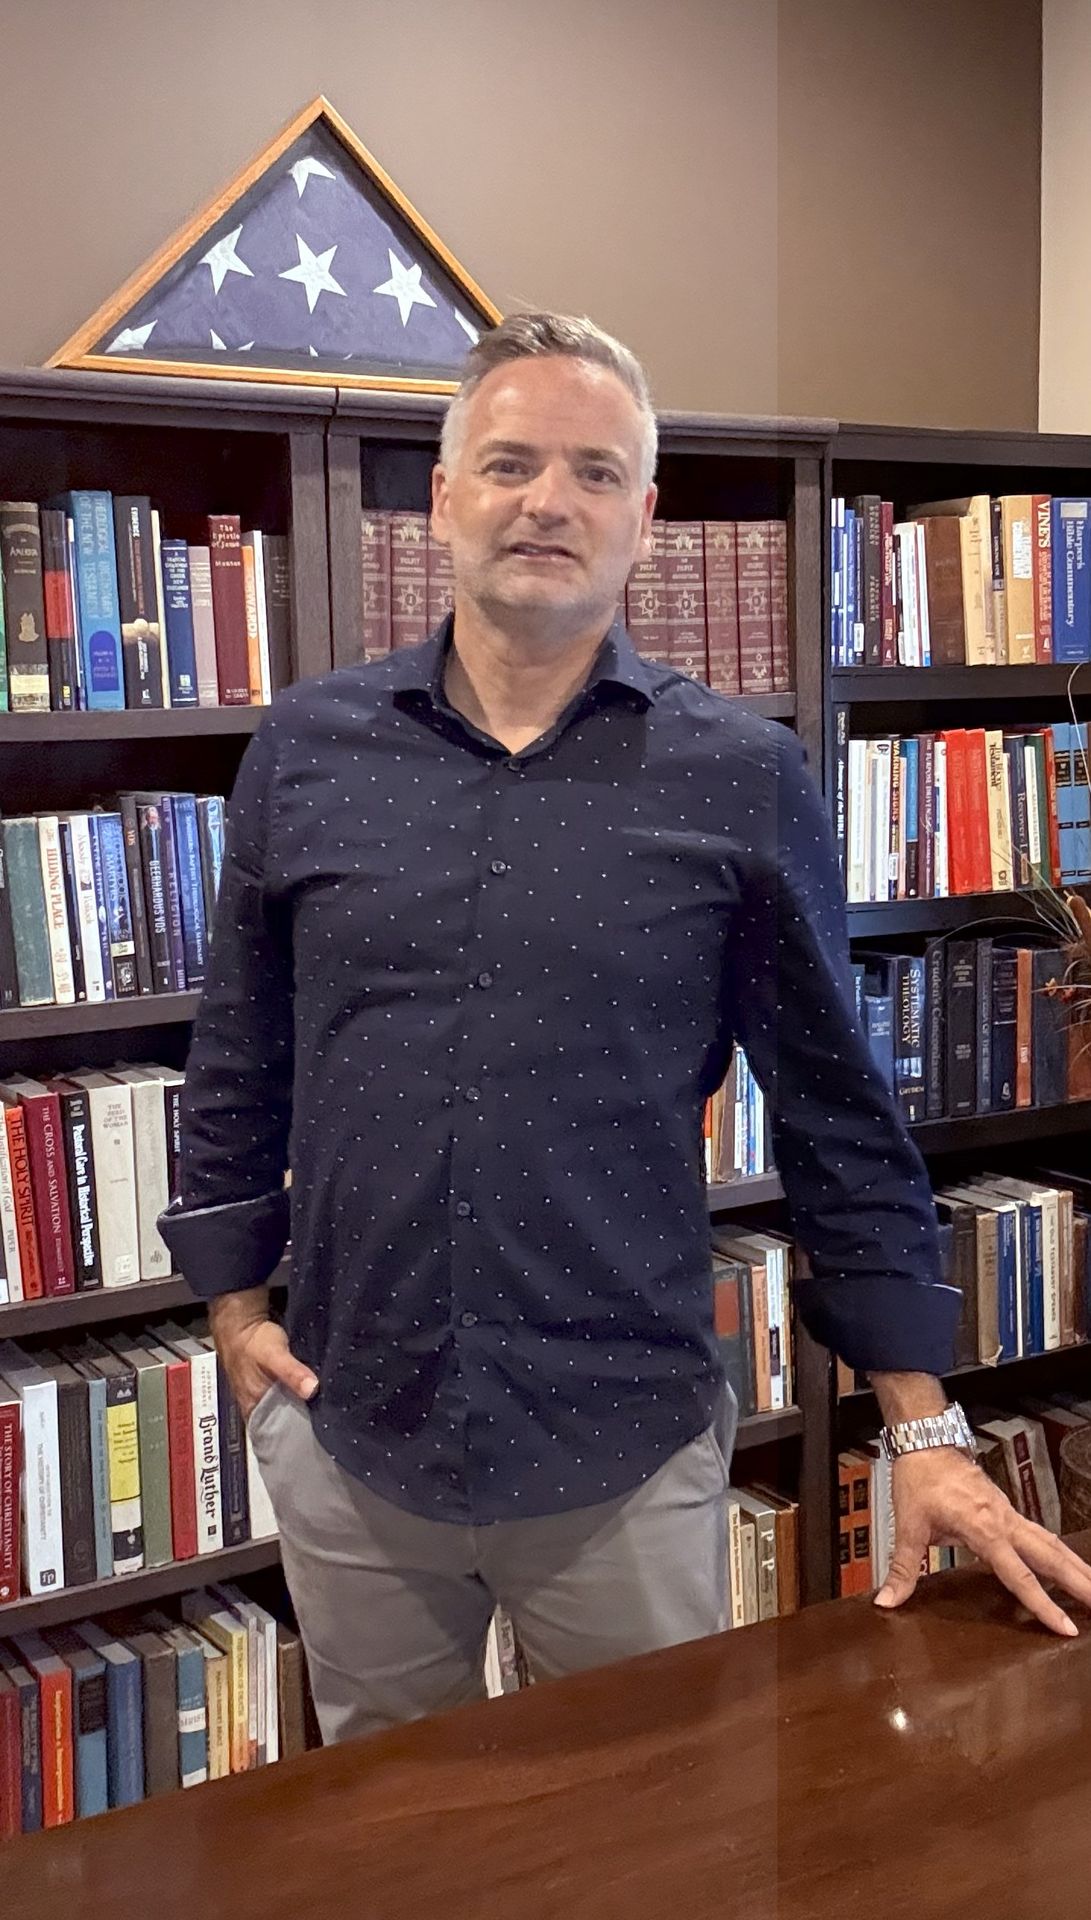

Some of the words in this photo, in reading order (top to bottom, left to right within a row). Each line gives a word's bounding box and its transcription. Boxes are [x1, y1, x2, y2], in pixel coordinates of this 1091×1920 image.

[79, 496, 90, 509] OF
[81, 512, 92, 532] THE
[95, 498, 110, 554] THEOLOGICAL
[131, 507, 140, 537] EVIDENCE
[1038, 500, 1050, 548] VINE'S
[1066, 520, 1074, 548] Bible
[82, 534, 94, 554] NEW
[1075, 520, 1084, 569] Harper's
[84, 562, 98, 618] TESTAMENT
[1065, 550, 1075, 627] Commentary
[836, 792, 844, 800] of
[127, 830, 136, 846] VOS
[46, 848, 61, 890] HIDING
[150, 860, 163, 915] GEERHARDUS
[51, 893, 64, 930] PLACE
[168, 872, 180, 936] RELIGION
[155, 916, 166, 934] VOS
[931, 950, 942, 1004] Cruden's
[902, 974, 910, 1044] THEOLOGY
[910, 969, 921, 1048] SYSTEMATIC
[931, 1007, 942, 1088] Concordance
[10, 1116, 25, 1144] THE
[42, 1106, 50, 1122] THE
[173, 1109, 181, 1129] HOLY
[43, 1123, 55, 1158] CROSS
[73, 1124, 86, 1158] Pastoral
[13, 1148, 30, 1184] HOLY
[47, 1160, 55, 1178] AND
[75, 1157, 87, 1176] Care
[77, 1176, 87, 1185] in
[2, 1185, 10, 1194] of
[3, 1195, 13, 1212] God
[78, 1186, 92, 1223] Historical
[18, 1186, 34, 1226] SPIRIT
[48, 1179, 61, 1234] SALVATION
[6, 1229, 16, 1254] PIPER
[80, 1225, 94, 1267] Perspective
[4, 1424, 13, 1444] THE
[198, 1413, 218, 1463] Brand
[4, 1446, 14, 1476] STORY
[4, 1478, 13, 1494] OF
[39, 1487, 45, 1495] OF
[200, 1465, 219, 1518] Luther
[3, 1496, 14, 1569] CHRISTIANITY
[760, 1528, 774, 1542] P
[761, 1557, 775, 1571] P
